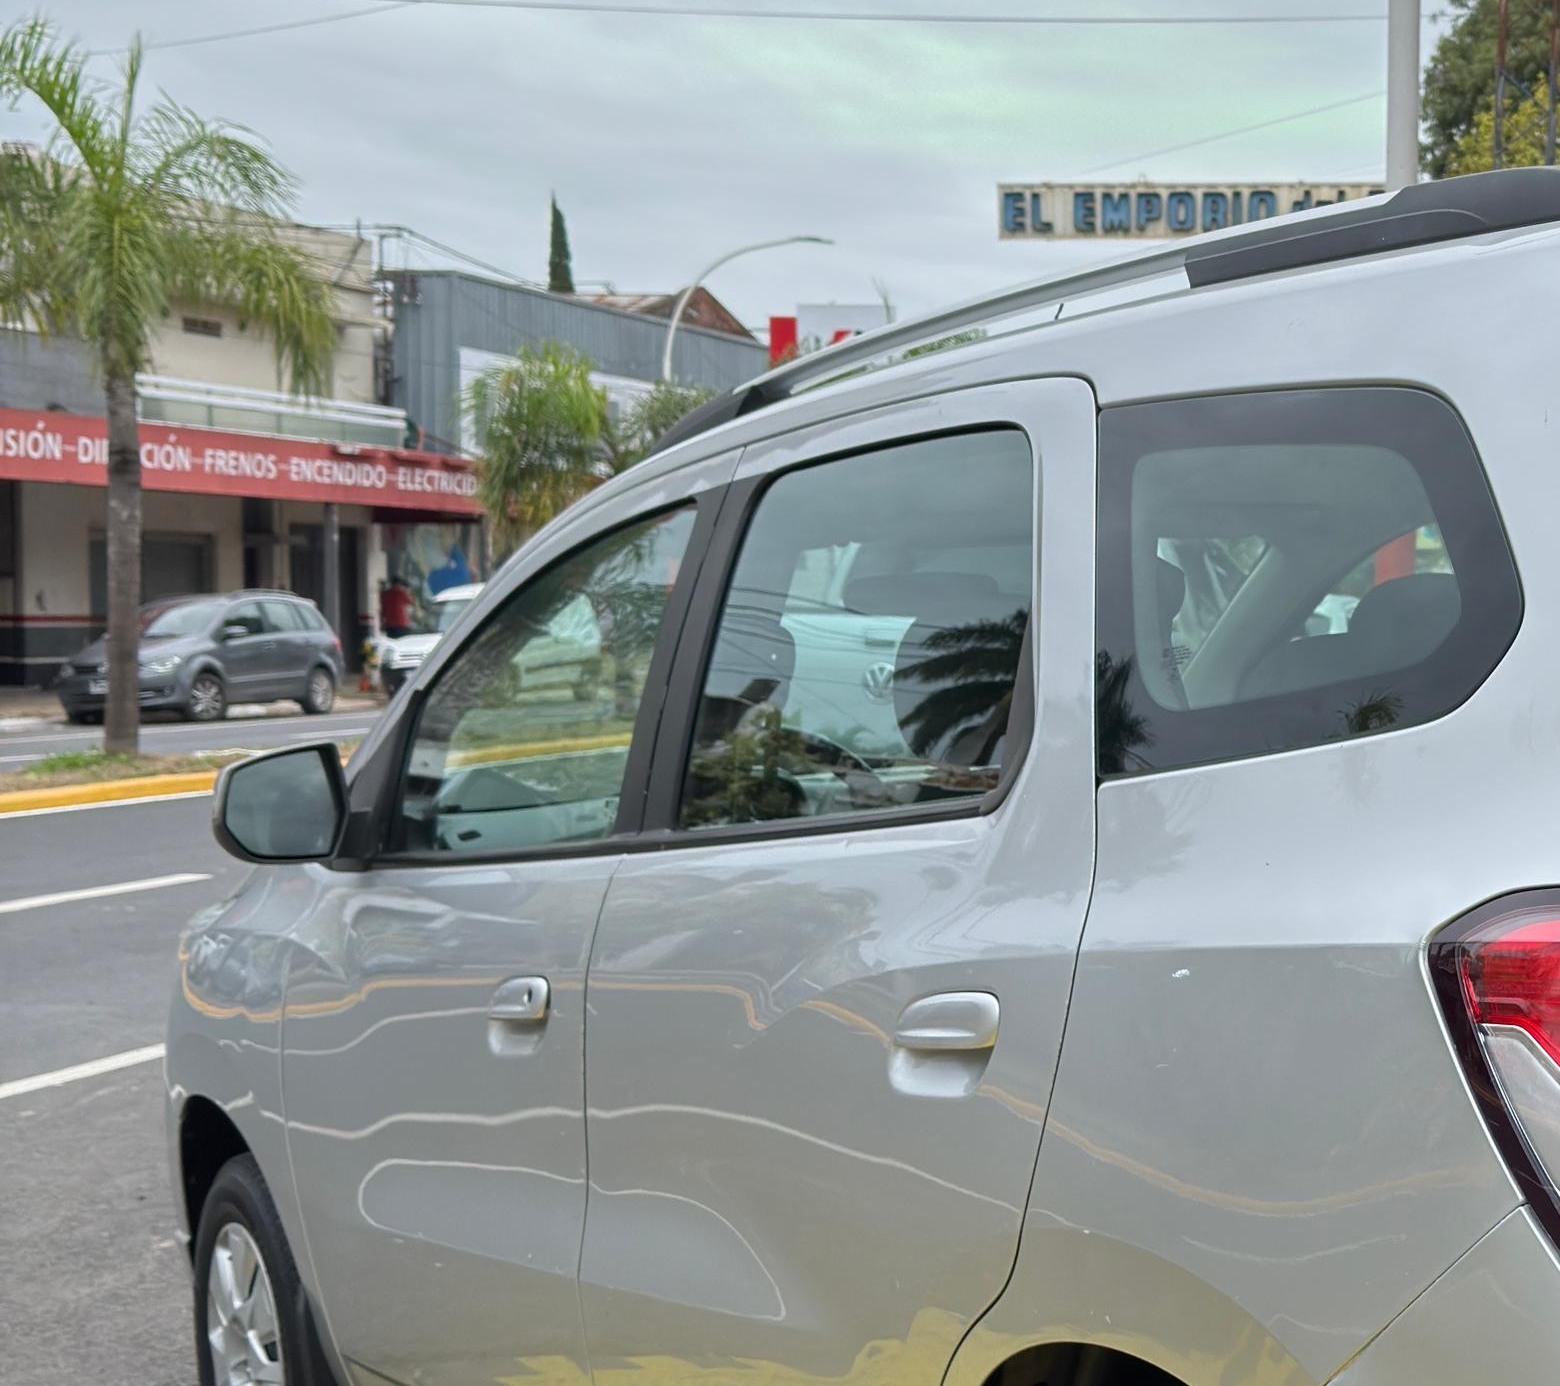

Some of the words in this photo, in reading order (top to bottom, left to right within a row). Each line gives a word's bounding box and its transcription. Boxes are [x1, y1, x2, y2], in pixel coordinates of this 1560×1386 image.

[1004, 191, 1053, 232] EL
[1073, 190, 1276, 233] EMPORIO
[78, 433, 192, 473] DICIÓN
[203, 447, 277, 481] FRENOS
[289, 456, 387, 489] ENCENDIDO
[398, 467, 479, 497] ELECTRICID
